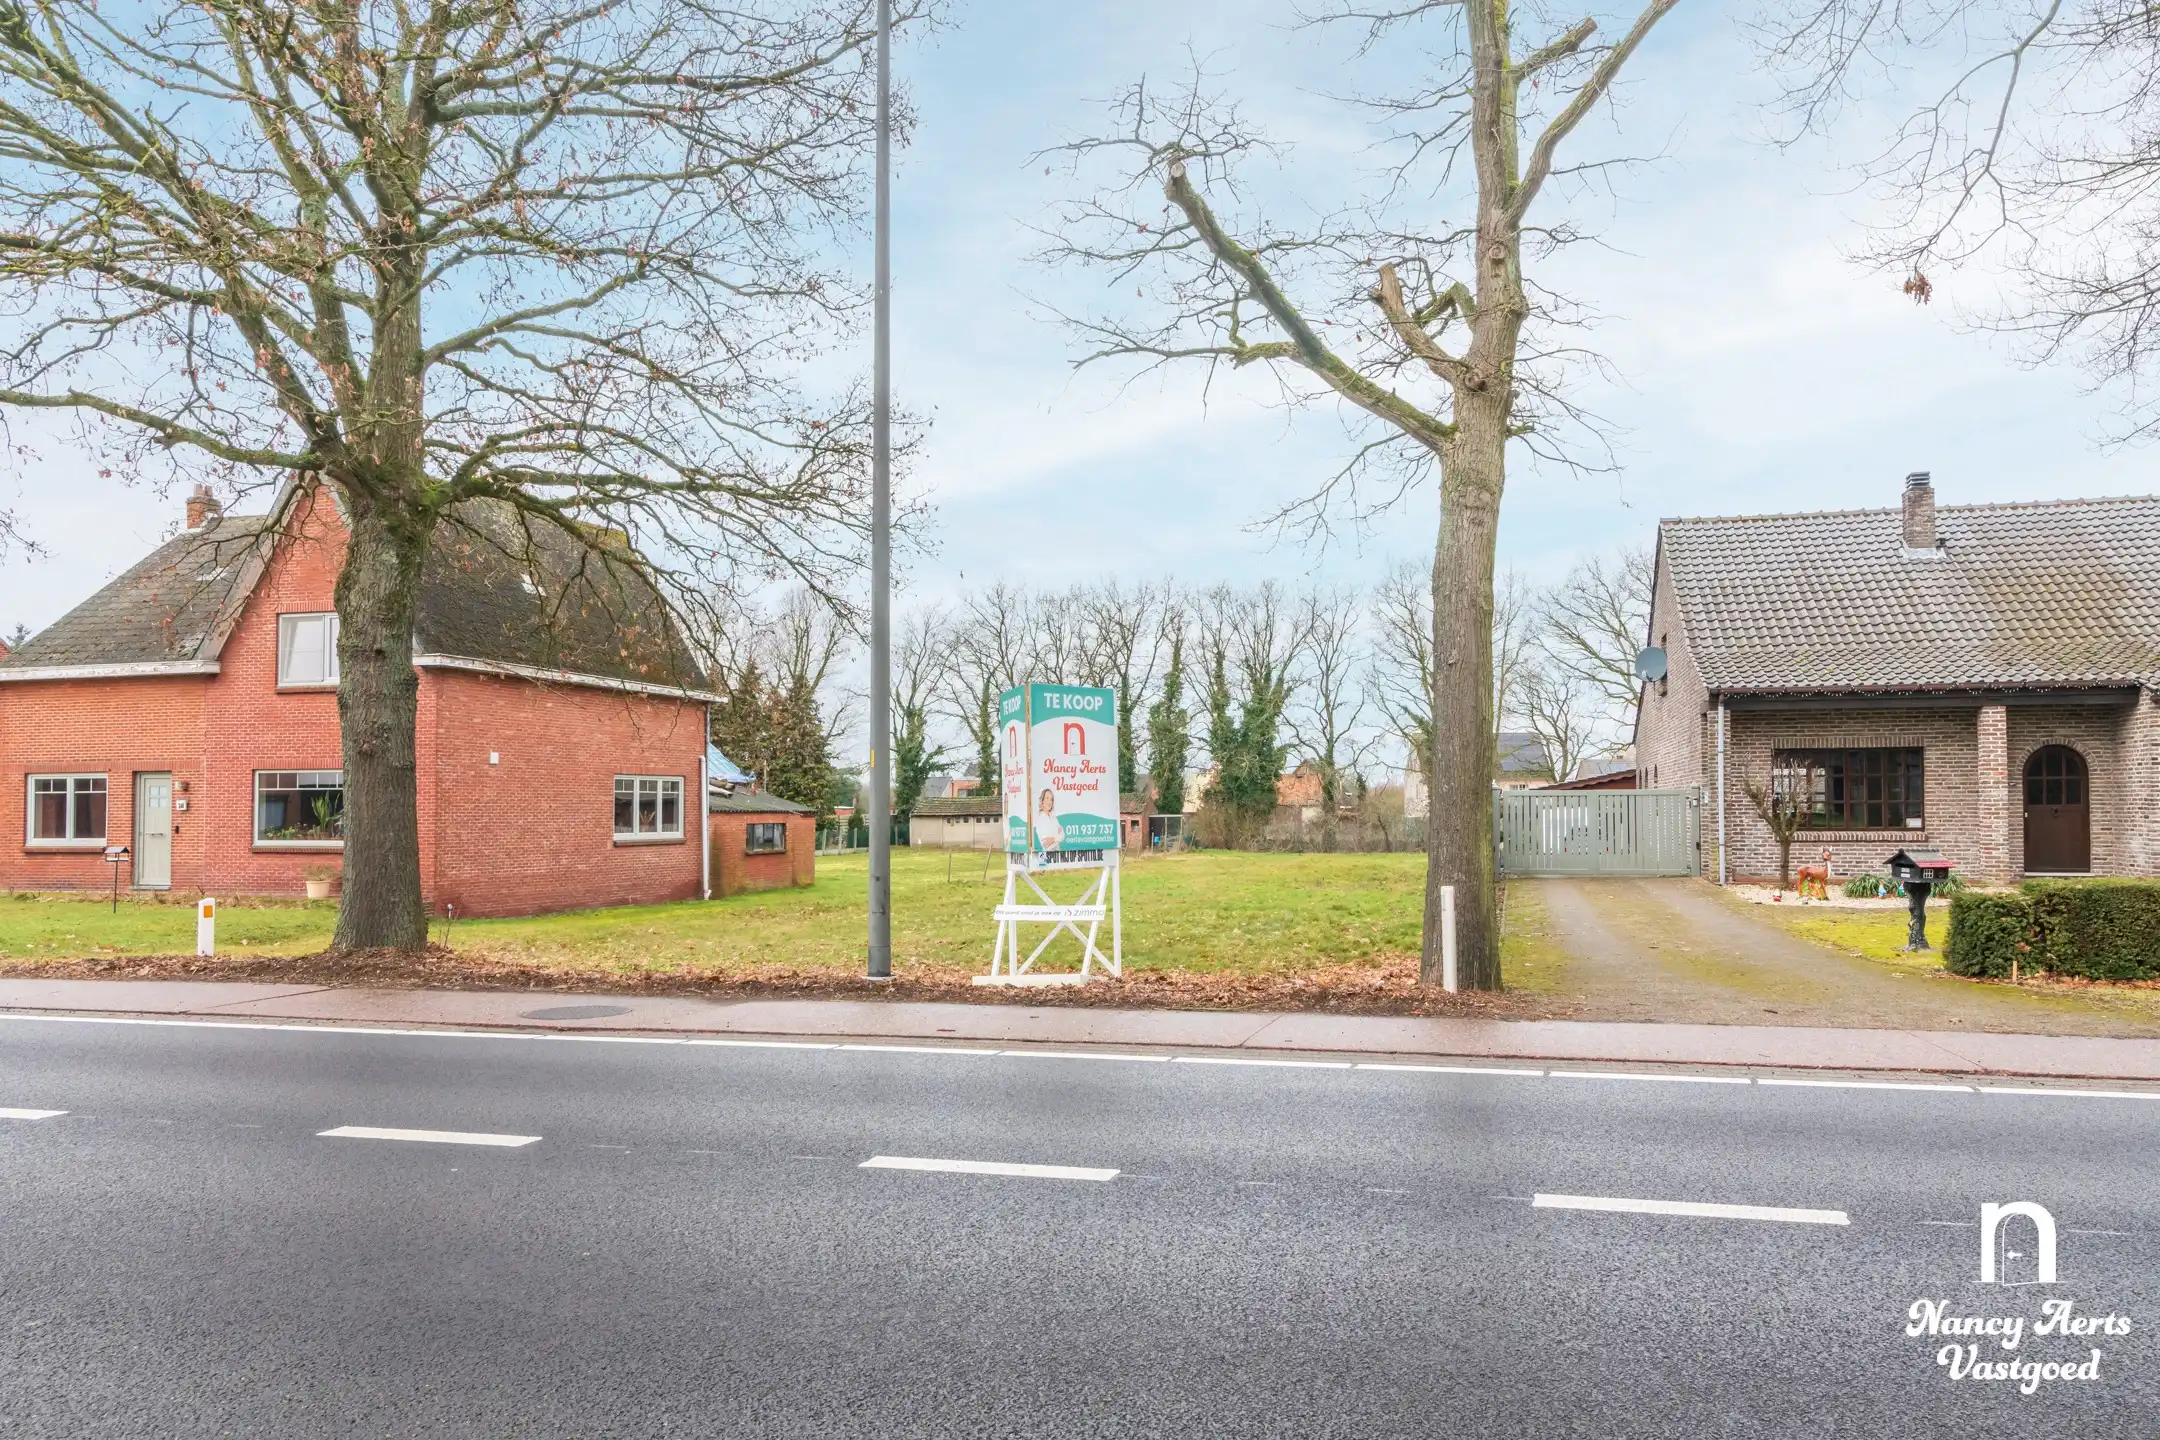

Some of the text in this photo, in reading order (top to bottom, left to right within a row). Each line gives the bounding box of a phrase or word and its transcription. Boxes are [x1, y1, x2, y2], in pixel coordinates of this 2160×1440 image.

[1044, 692, 1103, 712] TE KOOP
[1043, 758, 1077, 778] Nancy
[1080, 759, 1106, 774] Aerts
[1052, 776, 1098, 796] Vastgoed
[1066, 823, 1114, 836] 011 937 737
